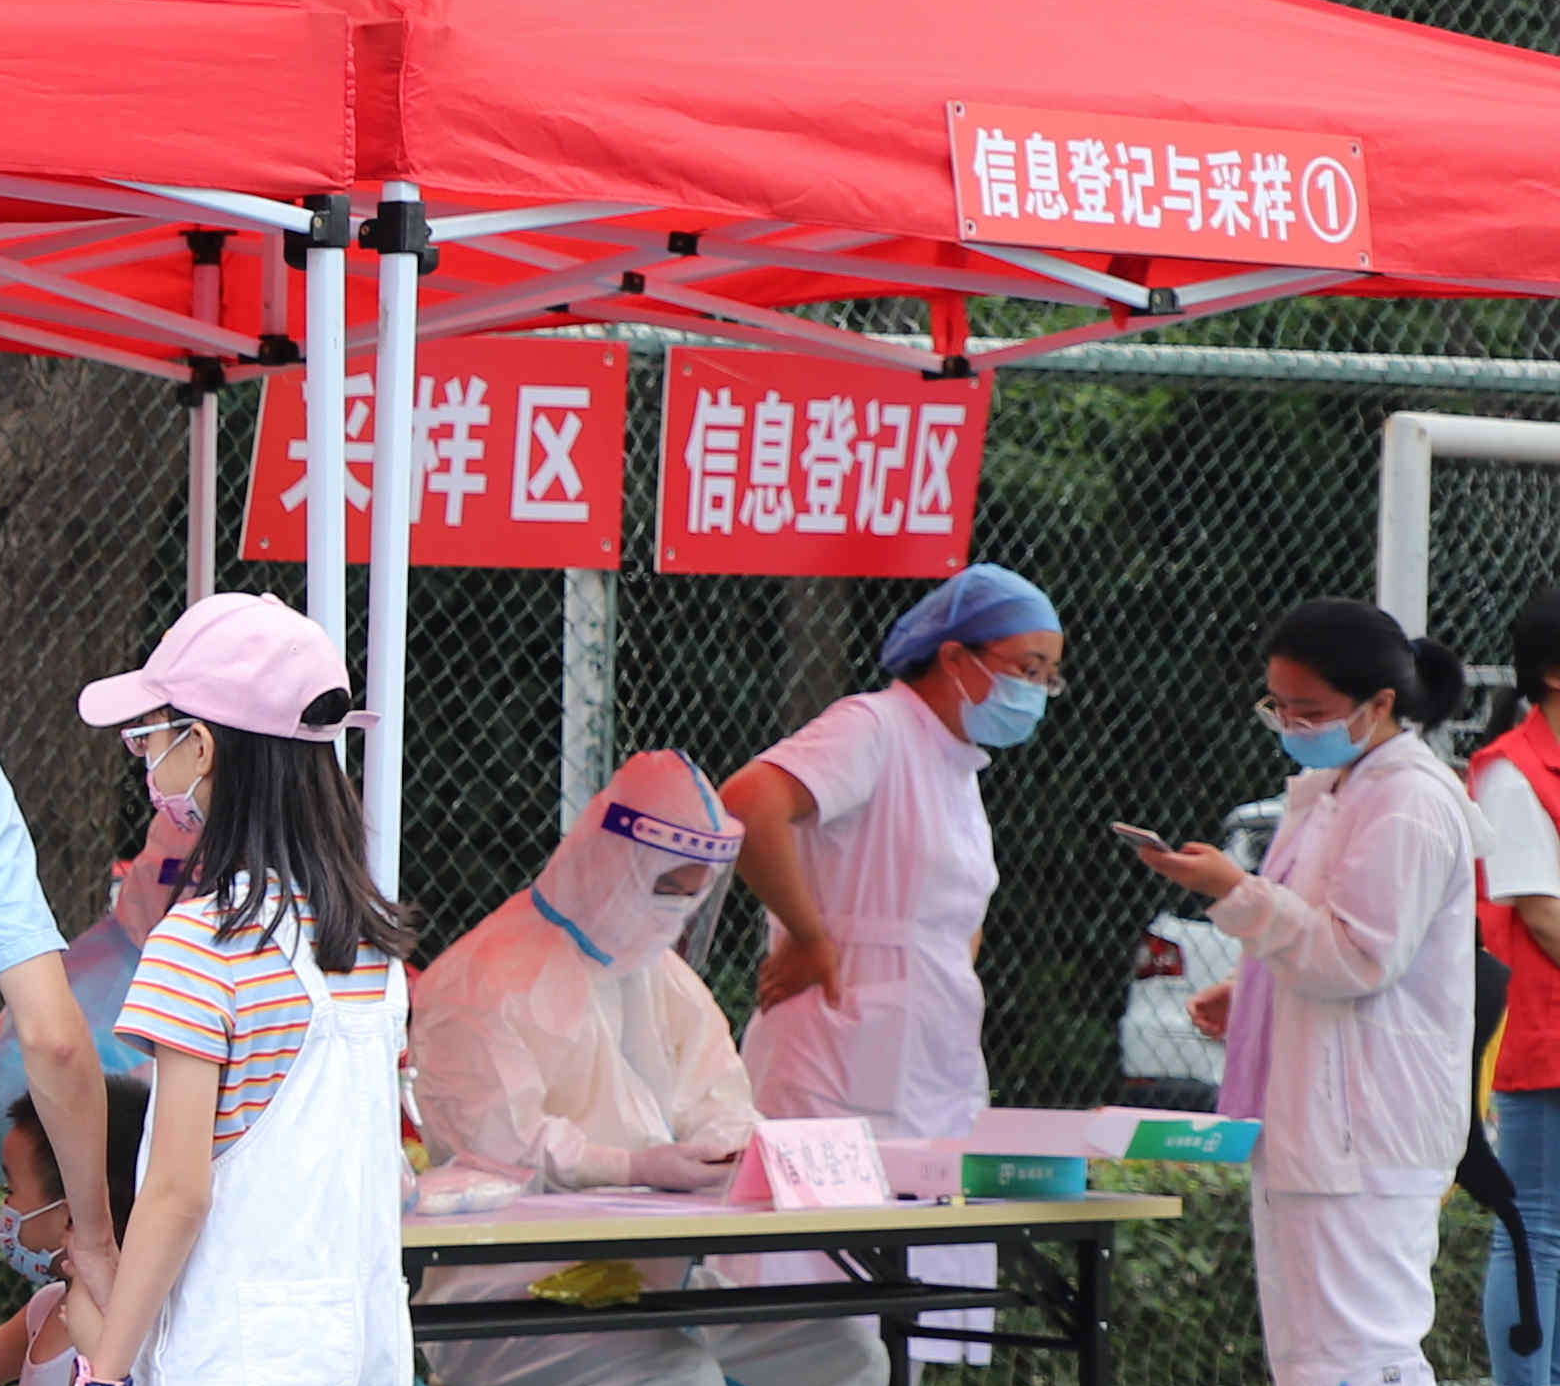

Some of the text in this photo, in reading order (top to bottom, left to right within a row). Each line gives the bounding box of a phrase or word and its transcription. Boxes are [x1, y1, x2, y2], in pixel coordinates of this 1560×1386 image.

[974, 127, 1358, 243] 信息登记与采样①
[685, 387, 966, 537] 信息登记区
